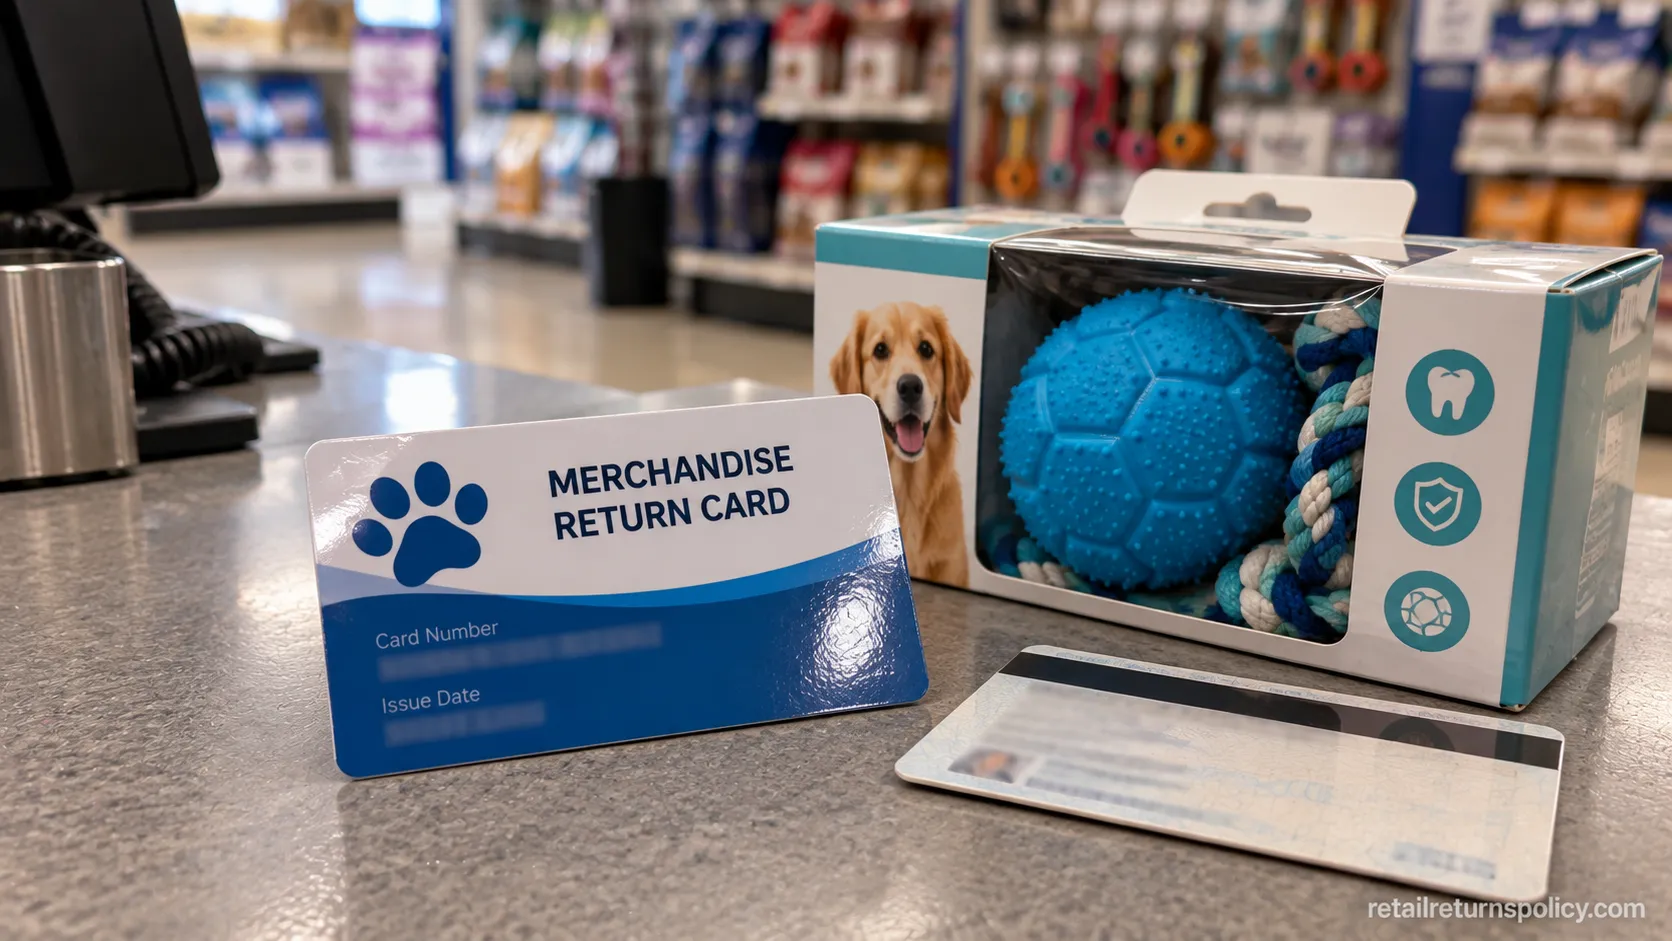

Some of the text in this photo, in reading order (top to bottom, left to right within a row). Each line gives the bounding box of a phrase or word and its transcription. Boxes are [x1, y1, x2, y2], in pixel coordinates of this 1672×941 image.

[547, 444, 794, 498] MERCHANDISE
[553, 487, 790, 541] RETURN CARD
[375, 622, 499, 650] Card Number
[382, 688, 481, 714] Issue Date
